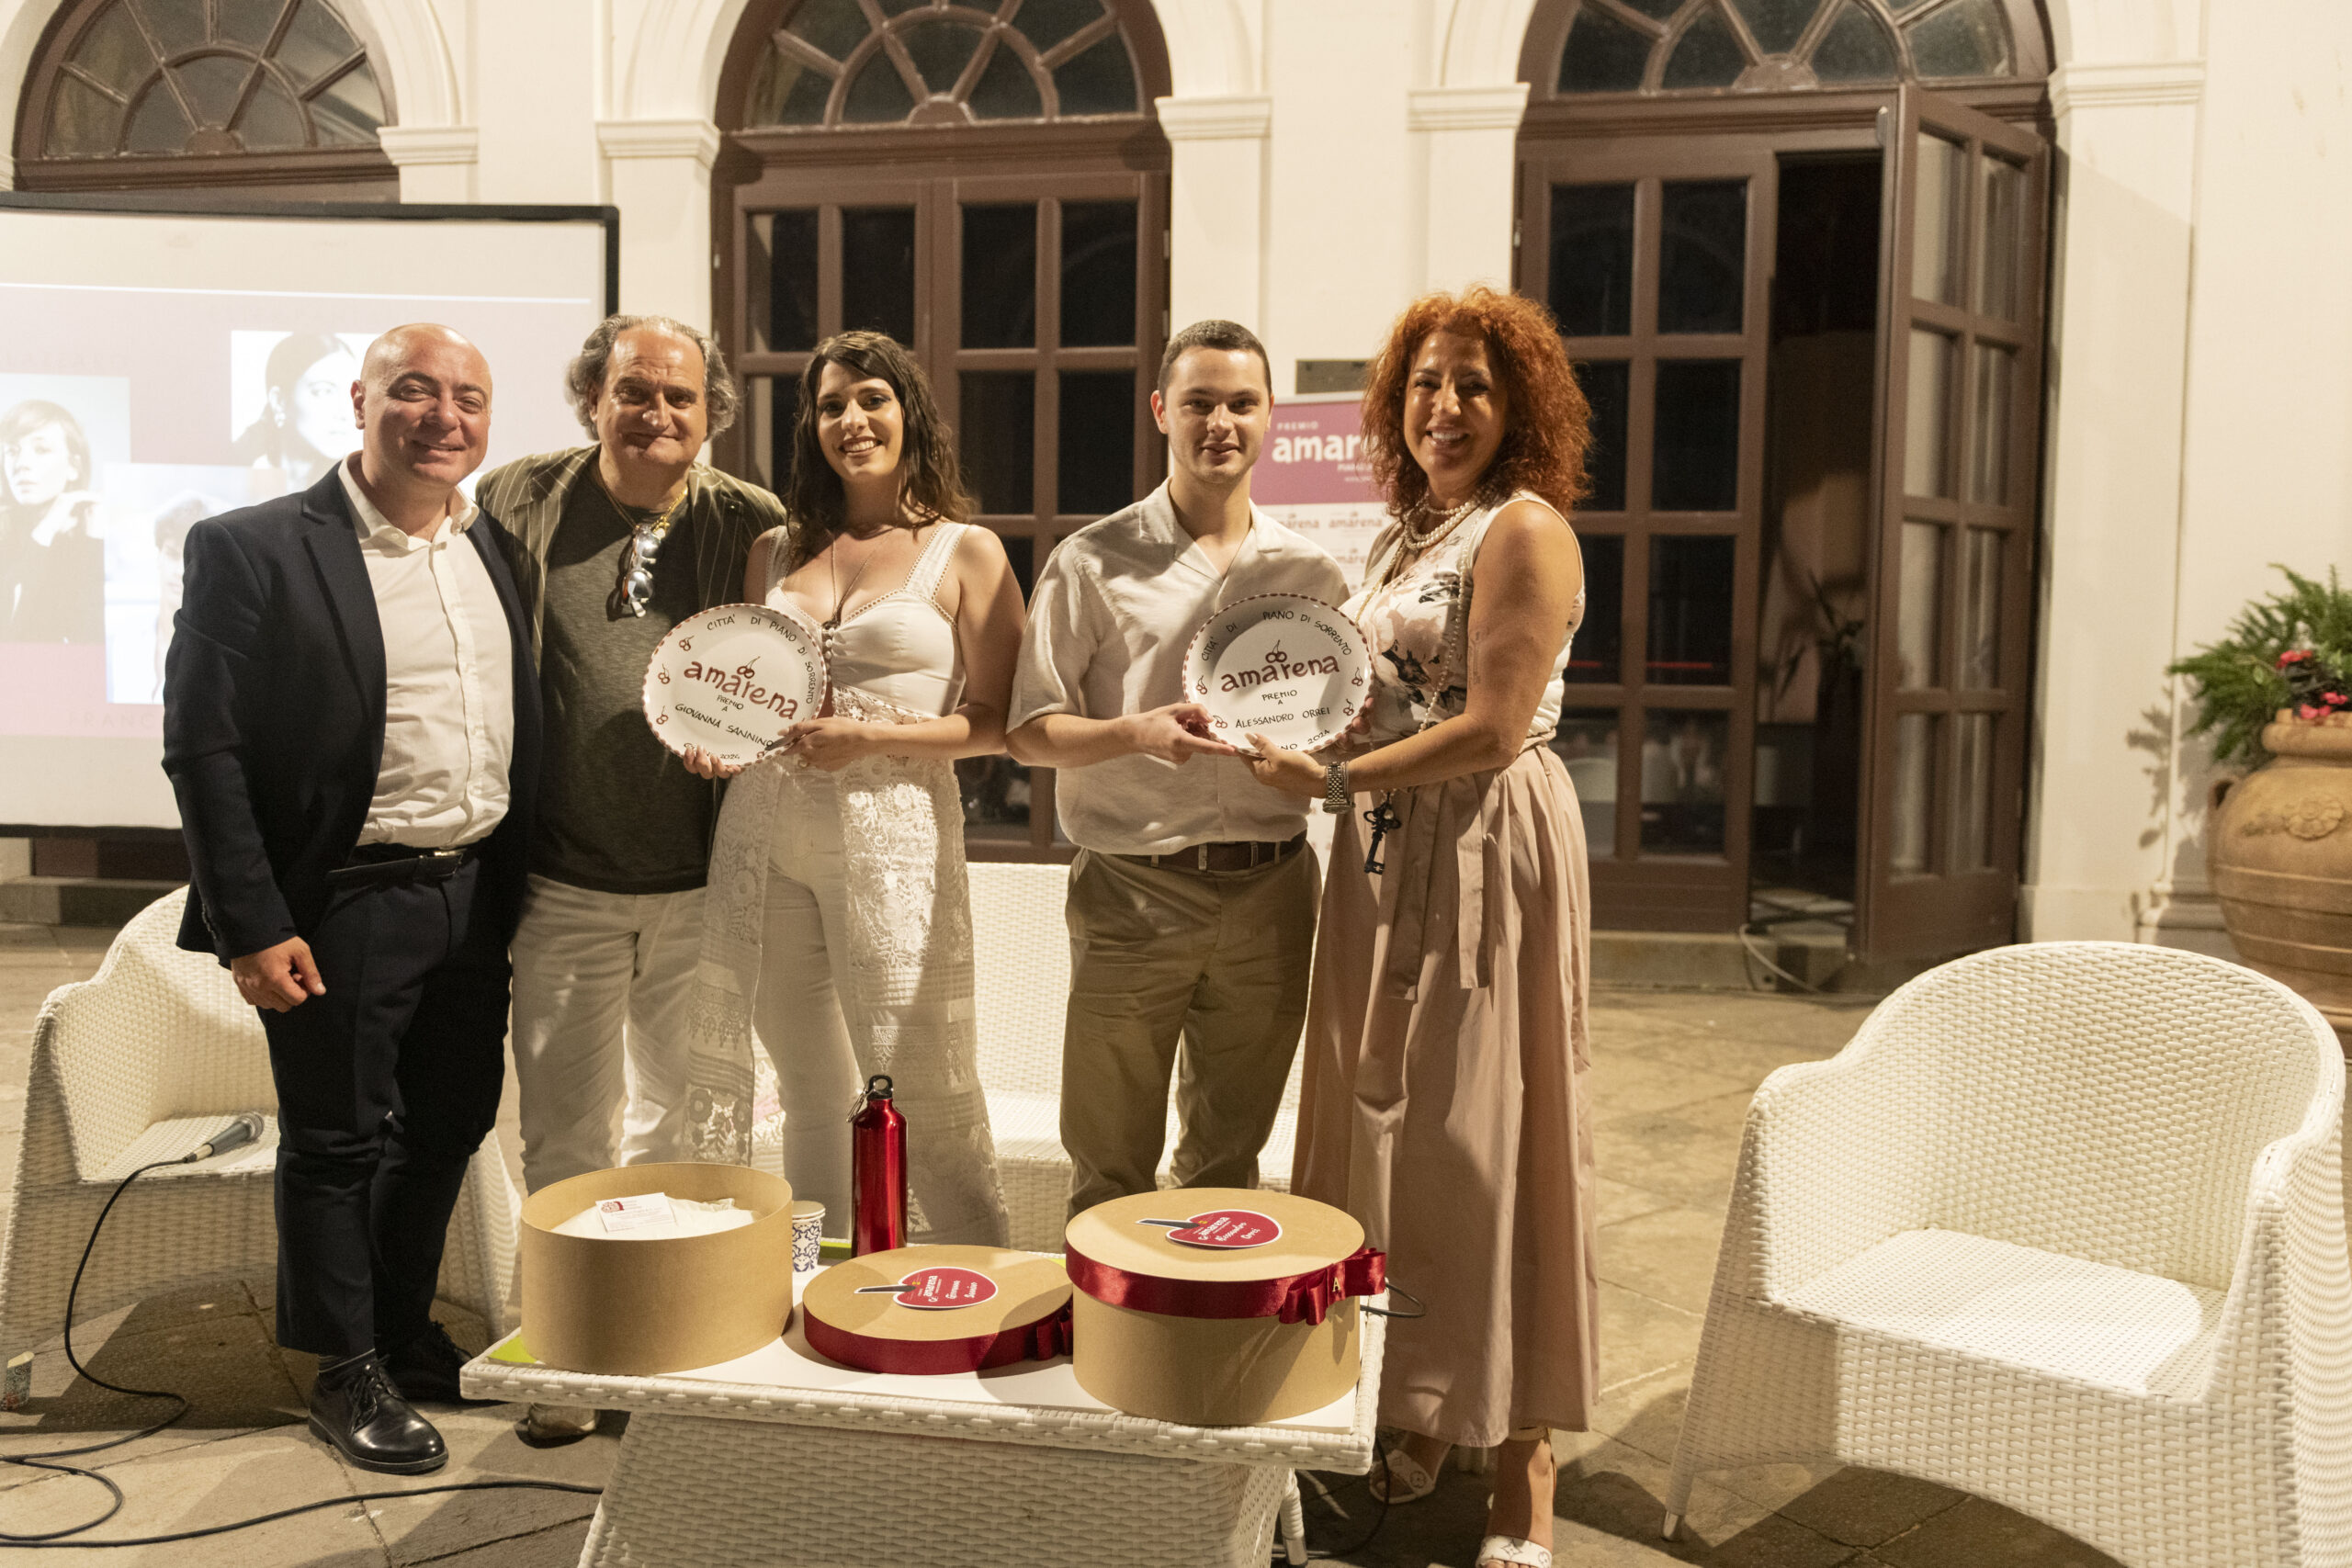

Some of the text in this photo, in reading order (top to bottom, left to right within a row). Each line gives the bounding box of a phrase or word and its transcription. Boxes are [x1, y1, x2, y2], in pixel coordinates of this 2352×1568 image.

[1276, 421, 1319, 431] PREMIO
[1272, 434, 1378, 463] amar
[1329, 518, 1383, 528] amarena
[1226, 622, 1238, 633] DI
[1262, 610, 1295, 621] PIANO
[1300, 614, 1311, 624] DI
[1314, 620, 1351, 656] SORRENTO
[707, 614, 818, 705] CITTA' DI PIANO DI SORRENTO
[1220, 655, 1340, 693] amarena
[684, 660, 798, 720] amarena
[716, 694, 744, 711] PREMIO
[1261, 689, 1297, 702] PREMIO
[674, 703, 774, 748] GIOVANNA SANNINO
[1235, 706, 1330, 728] ALESSANDRO ORREI
[1332, 1277, 1341, 1292] A
